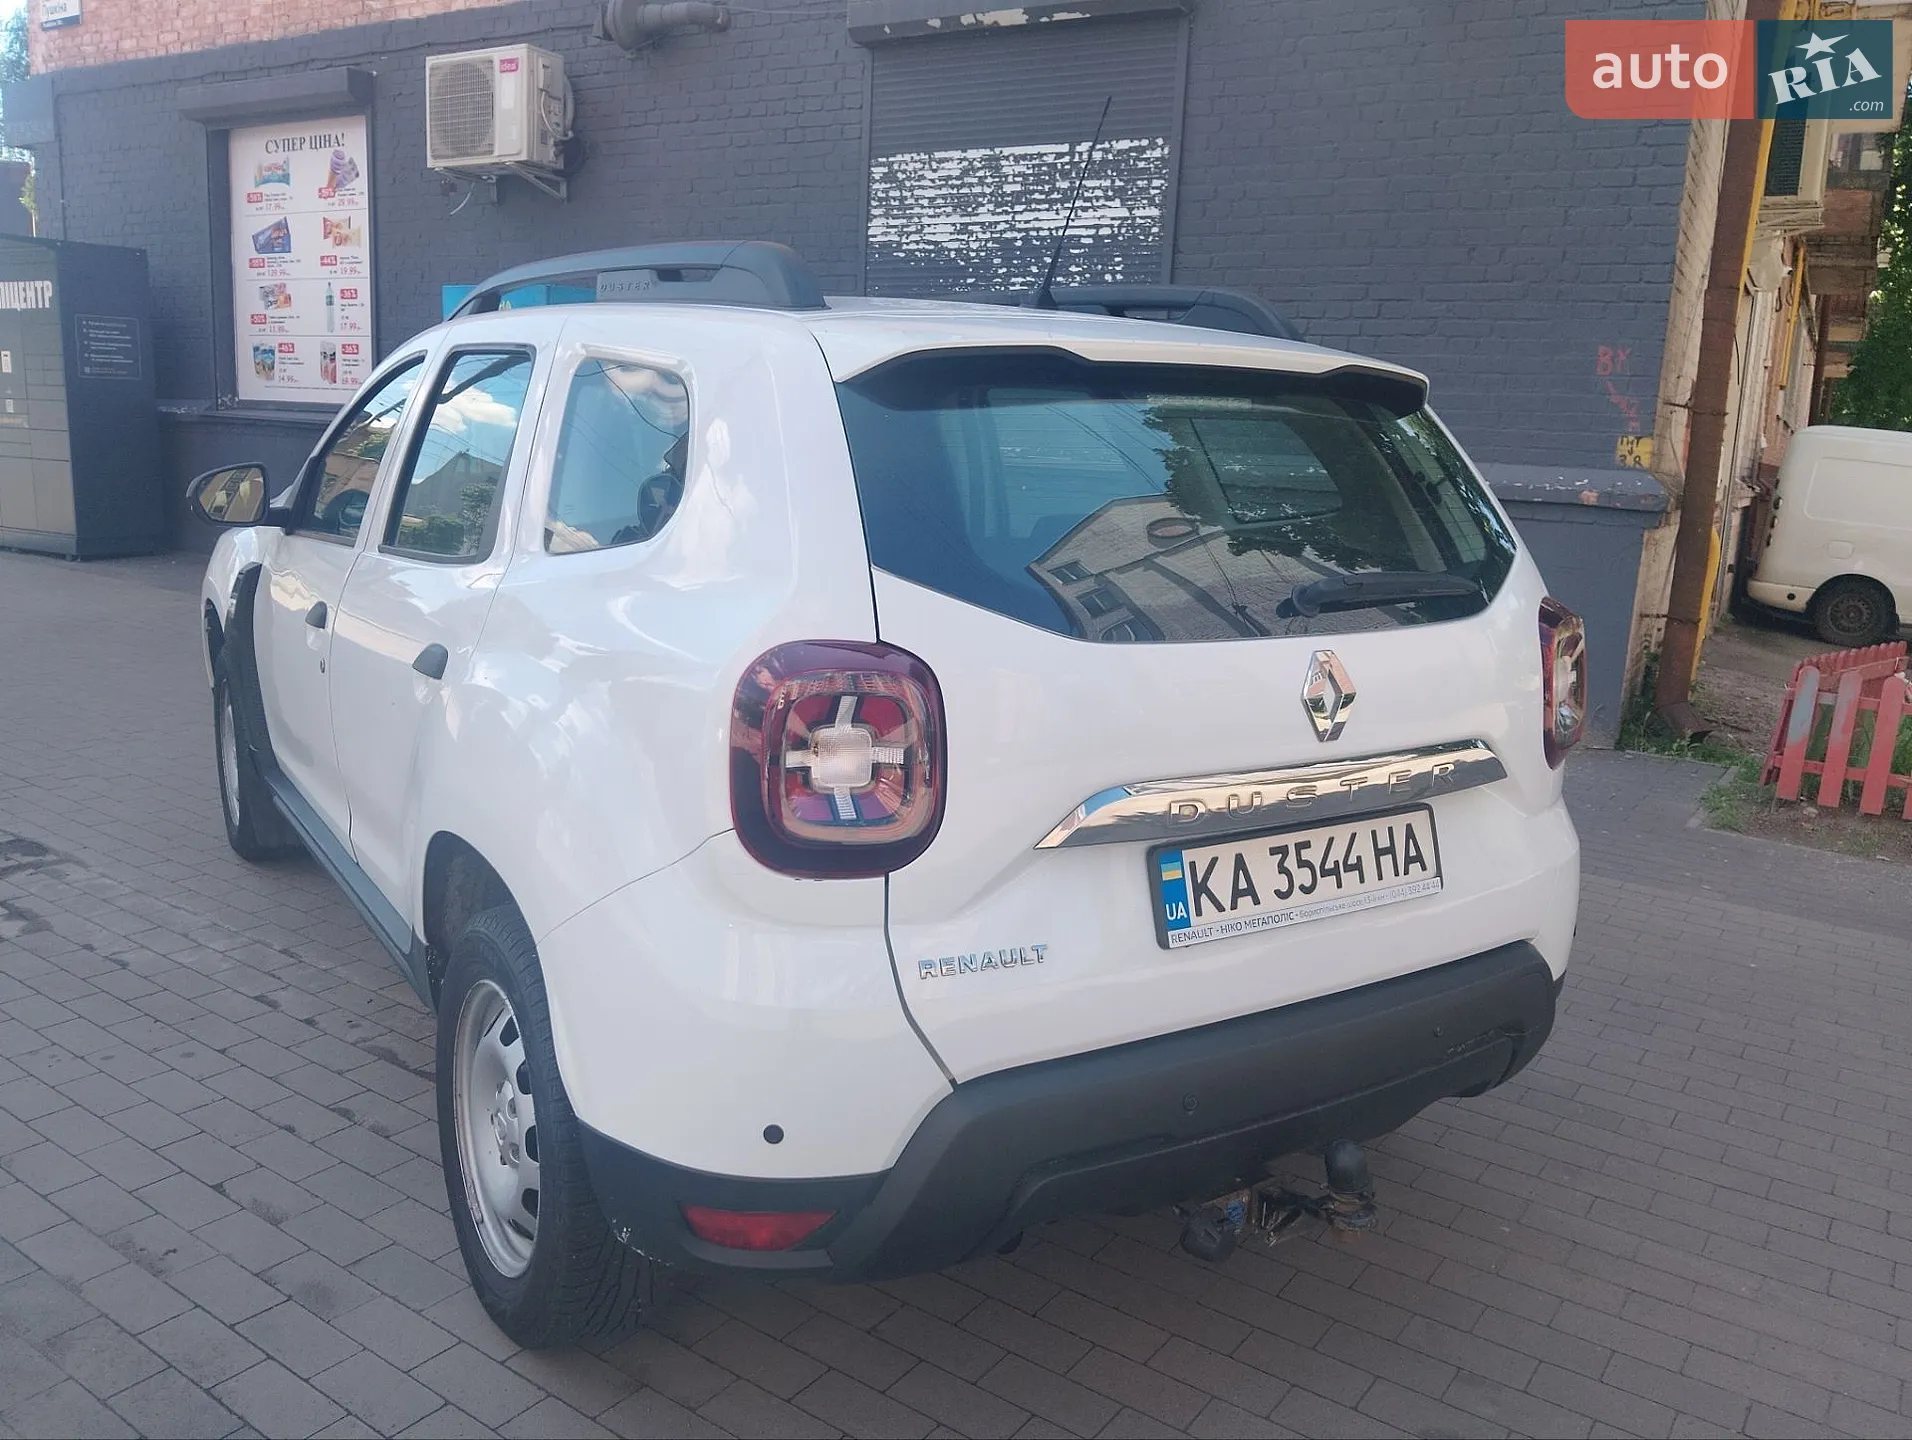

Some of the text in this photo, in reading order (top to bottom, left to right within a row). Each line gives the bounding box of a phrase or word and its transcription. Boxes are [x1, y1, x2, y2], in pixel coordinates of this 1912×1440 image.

[265, 132, 345, 154] СУПЕР ЦІНА!
[1169, 762, 1456, 827] DUSTER
[1268, 832, 1365, 900] 3544
[1166, 901, 1188, 920] UA
[1171, 926, 1213, 944] RENAULT
[1220, 921, 1243, 934] НІКО
[1244, 911, 1295, 930] МЕГАПОЛІС
[918, 944, 1048, 979] RENAULT
